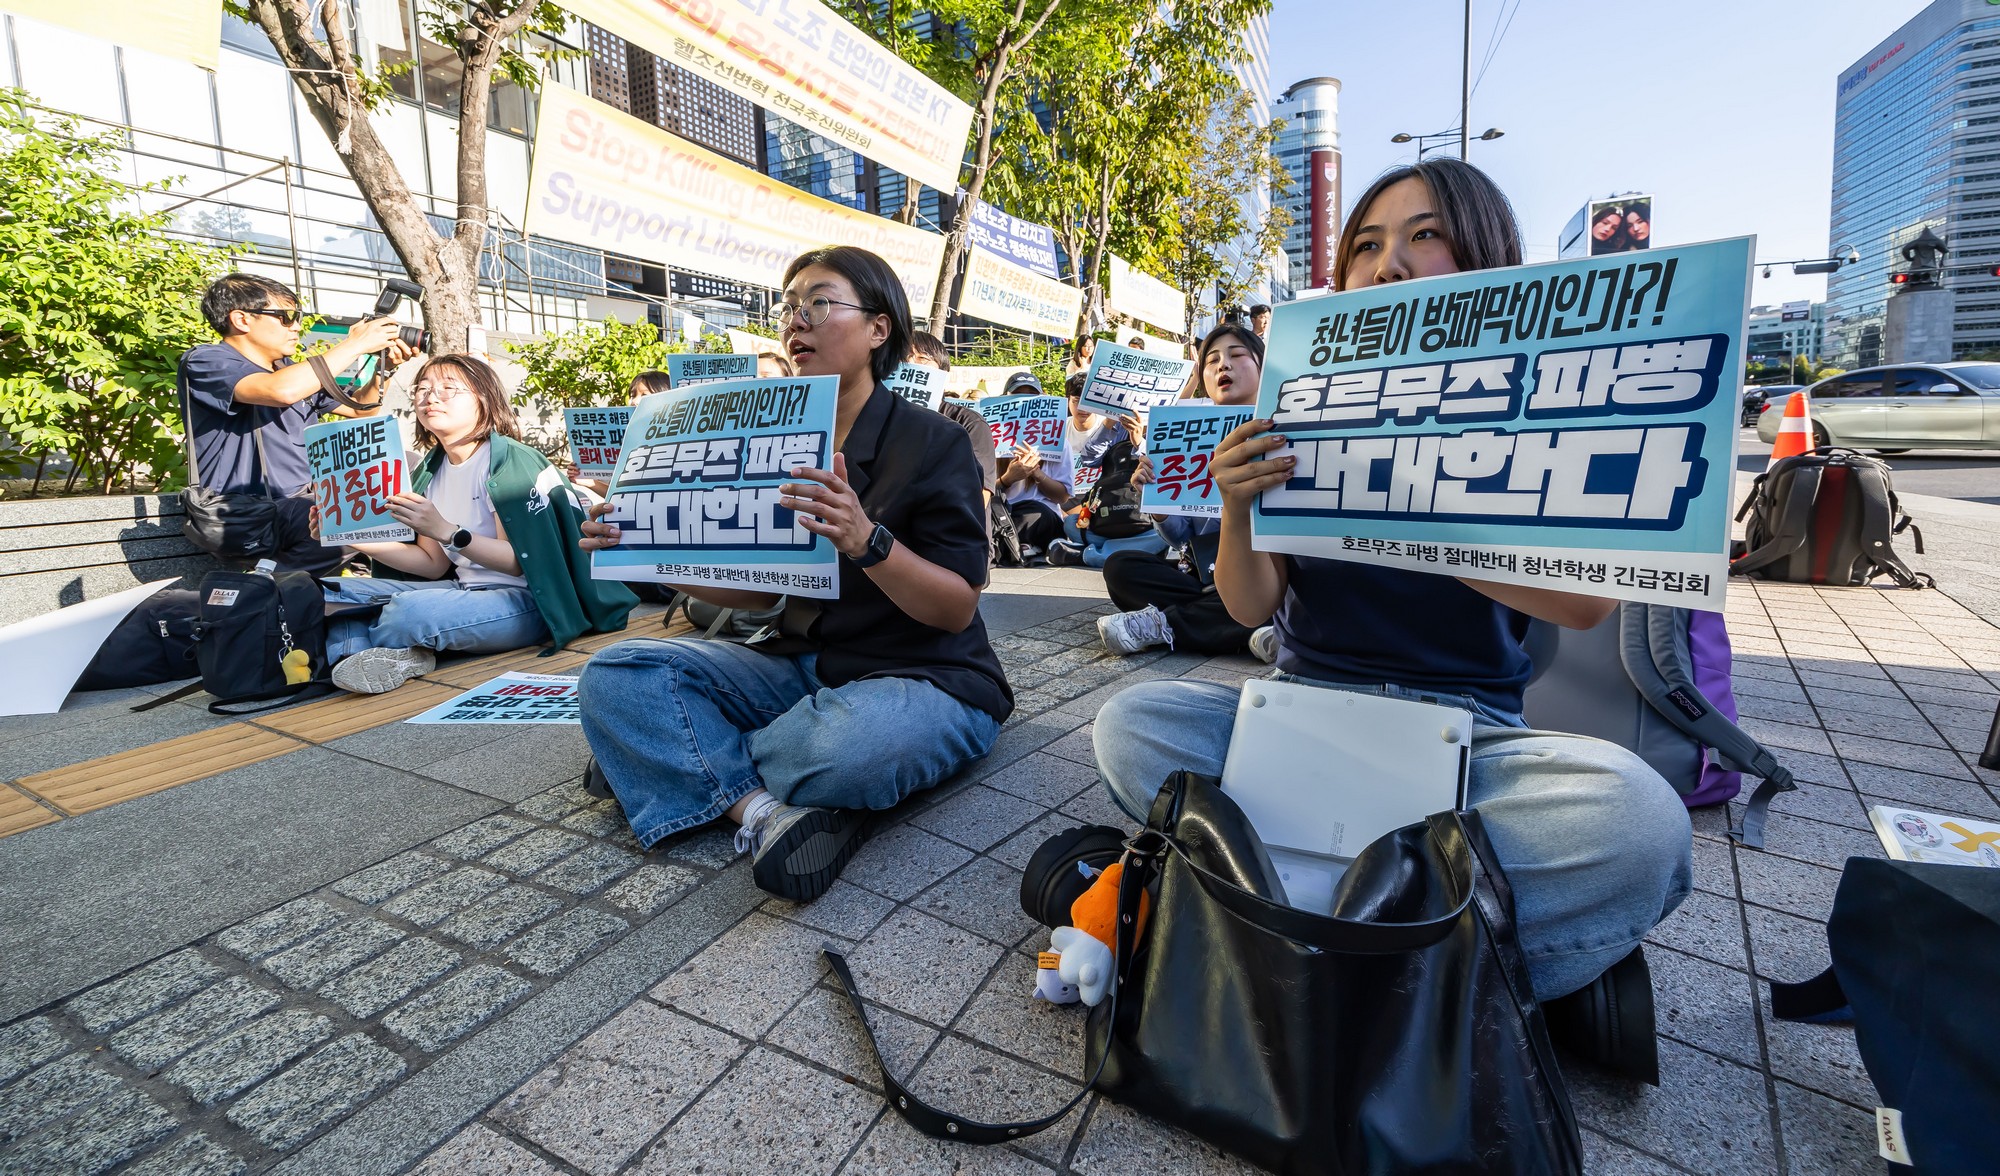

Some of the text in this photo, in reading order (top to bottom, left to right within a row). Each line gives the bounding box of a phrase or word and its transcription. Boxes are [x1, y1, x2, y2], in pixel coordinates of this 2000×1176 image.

[673, 36, 873, 151] 헬조선변혁 전국추진위원회
[827, 28, 893, 93] 탄압의
[891, 71, 929, 114] 표본
[926, 94, 953, 126] KT
[559, 106, 937, 271] Stop Killing Palestinian People!
[541, 170, 695, 253] Support
[1309, 295, 1421, 367] 청년들이
[1420, 258, 1680, 354] 방패막이인가?!
[899, 368, 930, 387] 해협
[1095, 365, 1158, 391] 호르무즈
[1108, 350, 1141, 371] 청년들이
[1273, 339, 1713, 425] 호르무즈 파병
[573, 411, 630, 426] 호르무즈 해협
[644, 383, 812, 440] 청년들이 방패막이인가?!
[1019, 398, 1060, 419] 파병검토
[330, 419, 387, 473] 파병검토
[570, 429, 607, 447] 한국군
[1022, 419, 1065, 447] 중단!
[1149, 417, 1221, 454] 호르무즈
[578, 448, 602, 465] 절대
[617, 434, 822, 482] 호르무즈 파병
[343, 458, 402, 522] 중단!
[1156, 452, 1215, 501] 즉각
[1180, 504, 1206, 513] 호르무즈
[390, 527, 412, 537] 긴급집회
[655, 562, 832, 591] 호르무즈 파병 절대반대 청년학생 긴급집회
[1341, 535, 1711, 597] 호르무즈 파병 절대반대 청년학생 긴급집회
[454, 694, 532, 709] 파병
[1882, 1115, 1898, 1154] SWU
